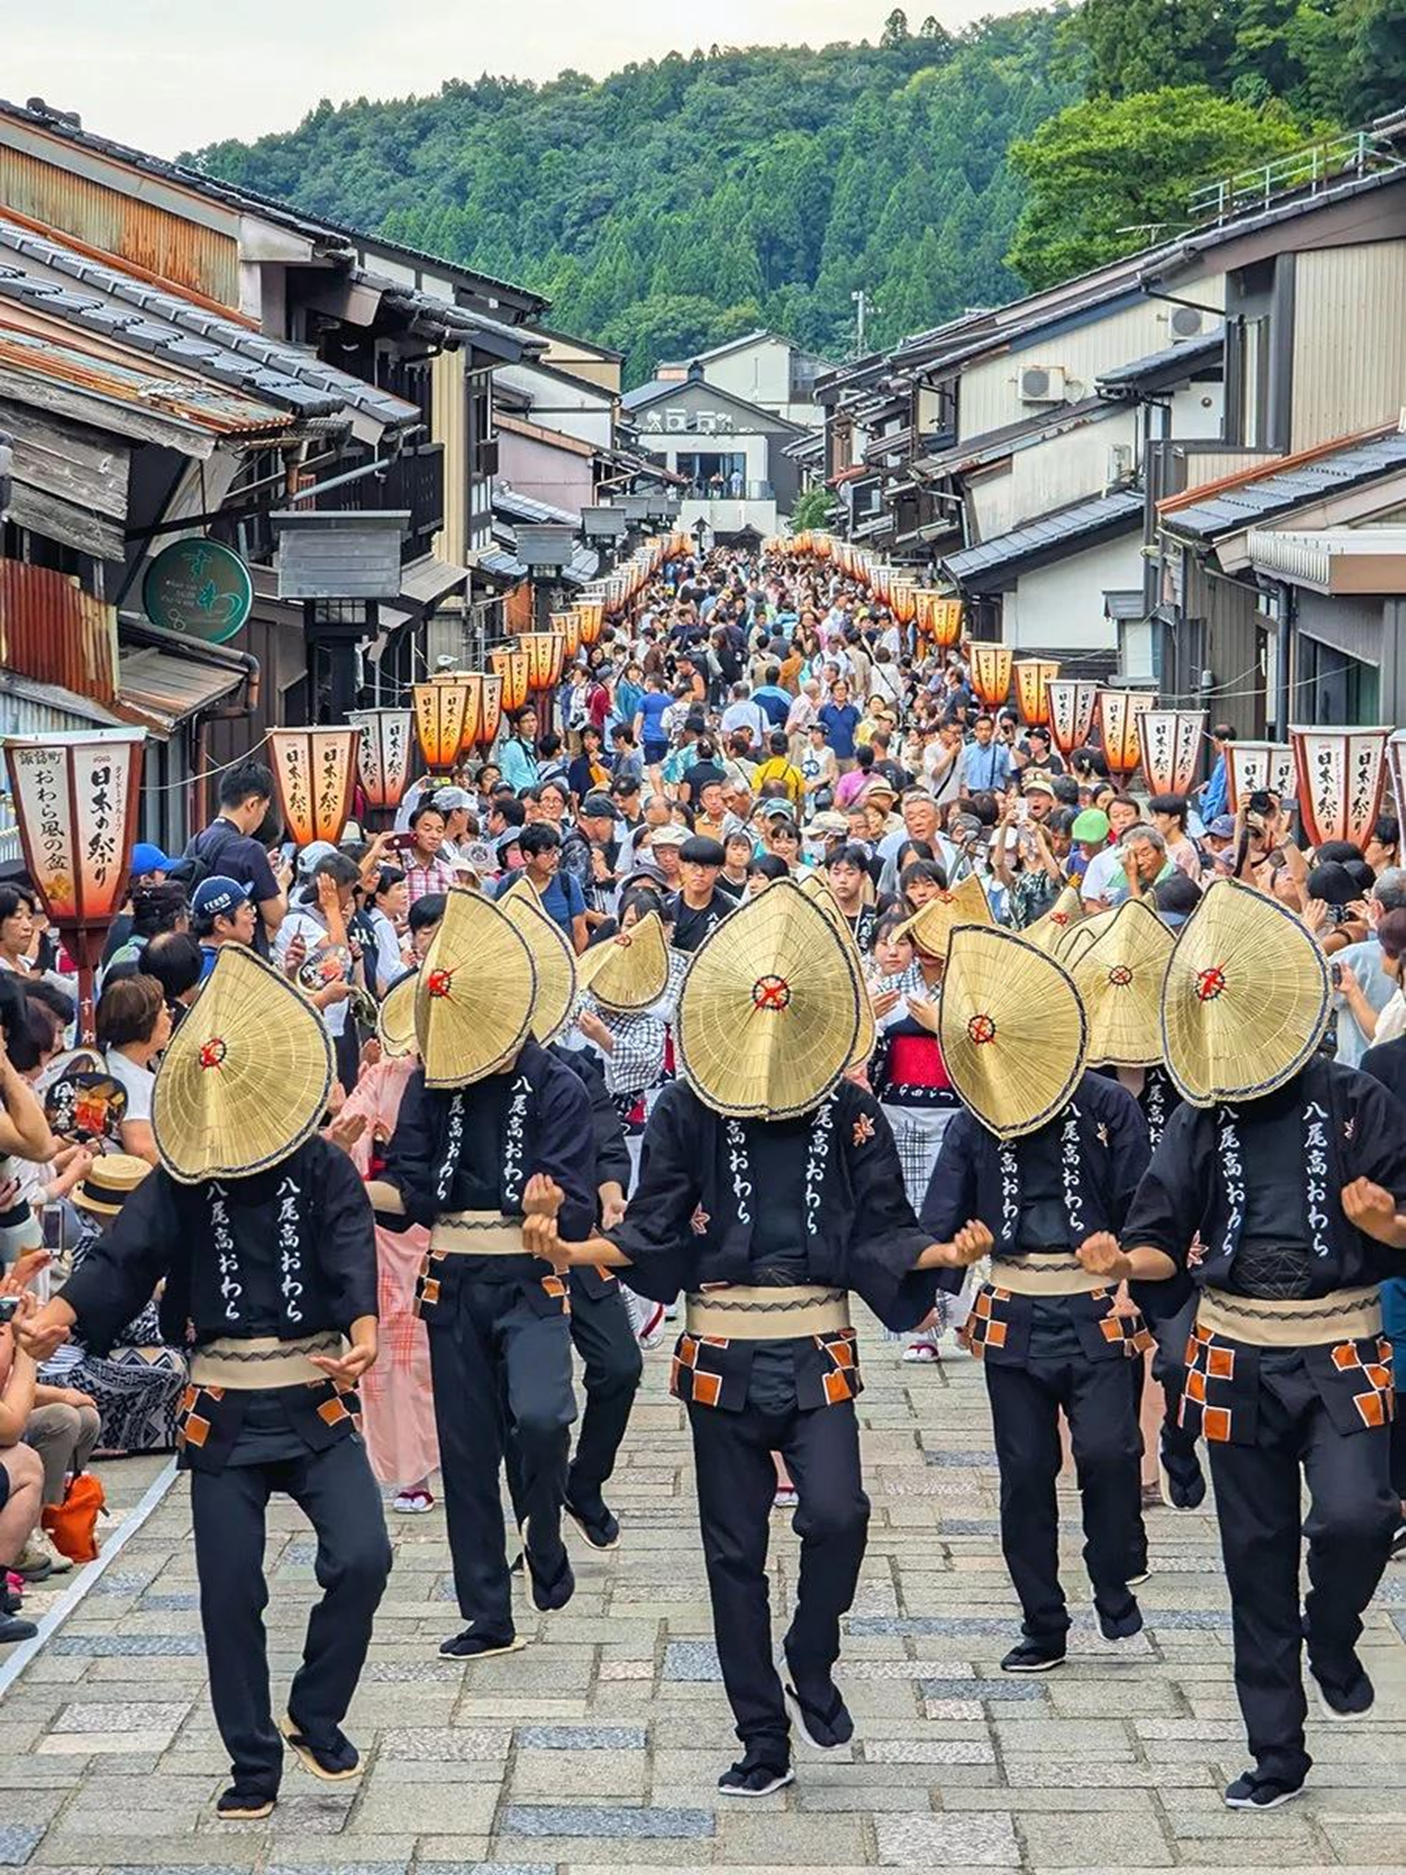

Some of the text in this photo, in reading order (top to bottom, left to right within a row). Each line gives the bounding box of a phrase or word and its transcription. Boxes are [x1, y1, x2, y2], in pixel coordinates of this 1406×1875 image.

[34, 769, 69, 872] おわら風の盆
[87, 765, 116, 889] 日本の祭り
[286, 749, 307, 828] 日本の祭り
[318, 748, 339, 828] 日本の祭り
[1317, 751, 1339, 836] 日本の祭り
[1350, 751, 1371, 836] 日本の祭り
[437, 1085, 466, 1201] 尾高おわら
[503, 1075, 534, 1202] 八尾高おわら
[725, 1119, 753, 1225] 高おわら
[1060, 1101, 1085, 1232] 八尾高おわら
[1216, 1105, 1246, 1256] 八尾高おわら
[1302, 1101, 1330, 1257] 八尾高おわら
[206, 1180, 243, 1320] 八尾高おわら
[276, 1176, 304, 1323] 八尾高おわら
